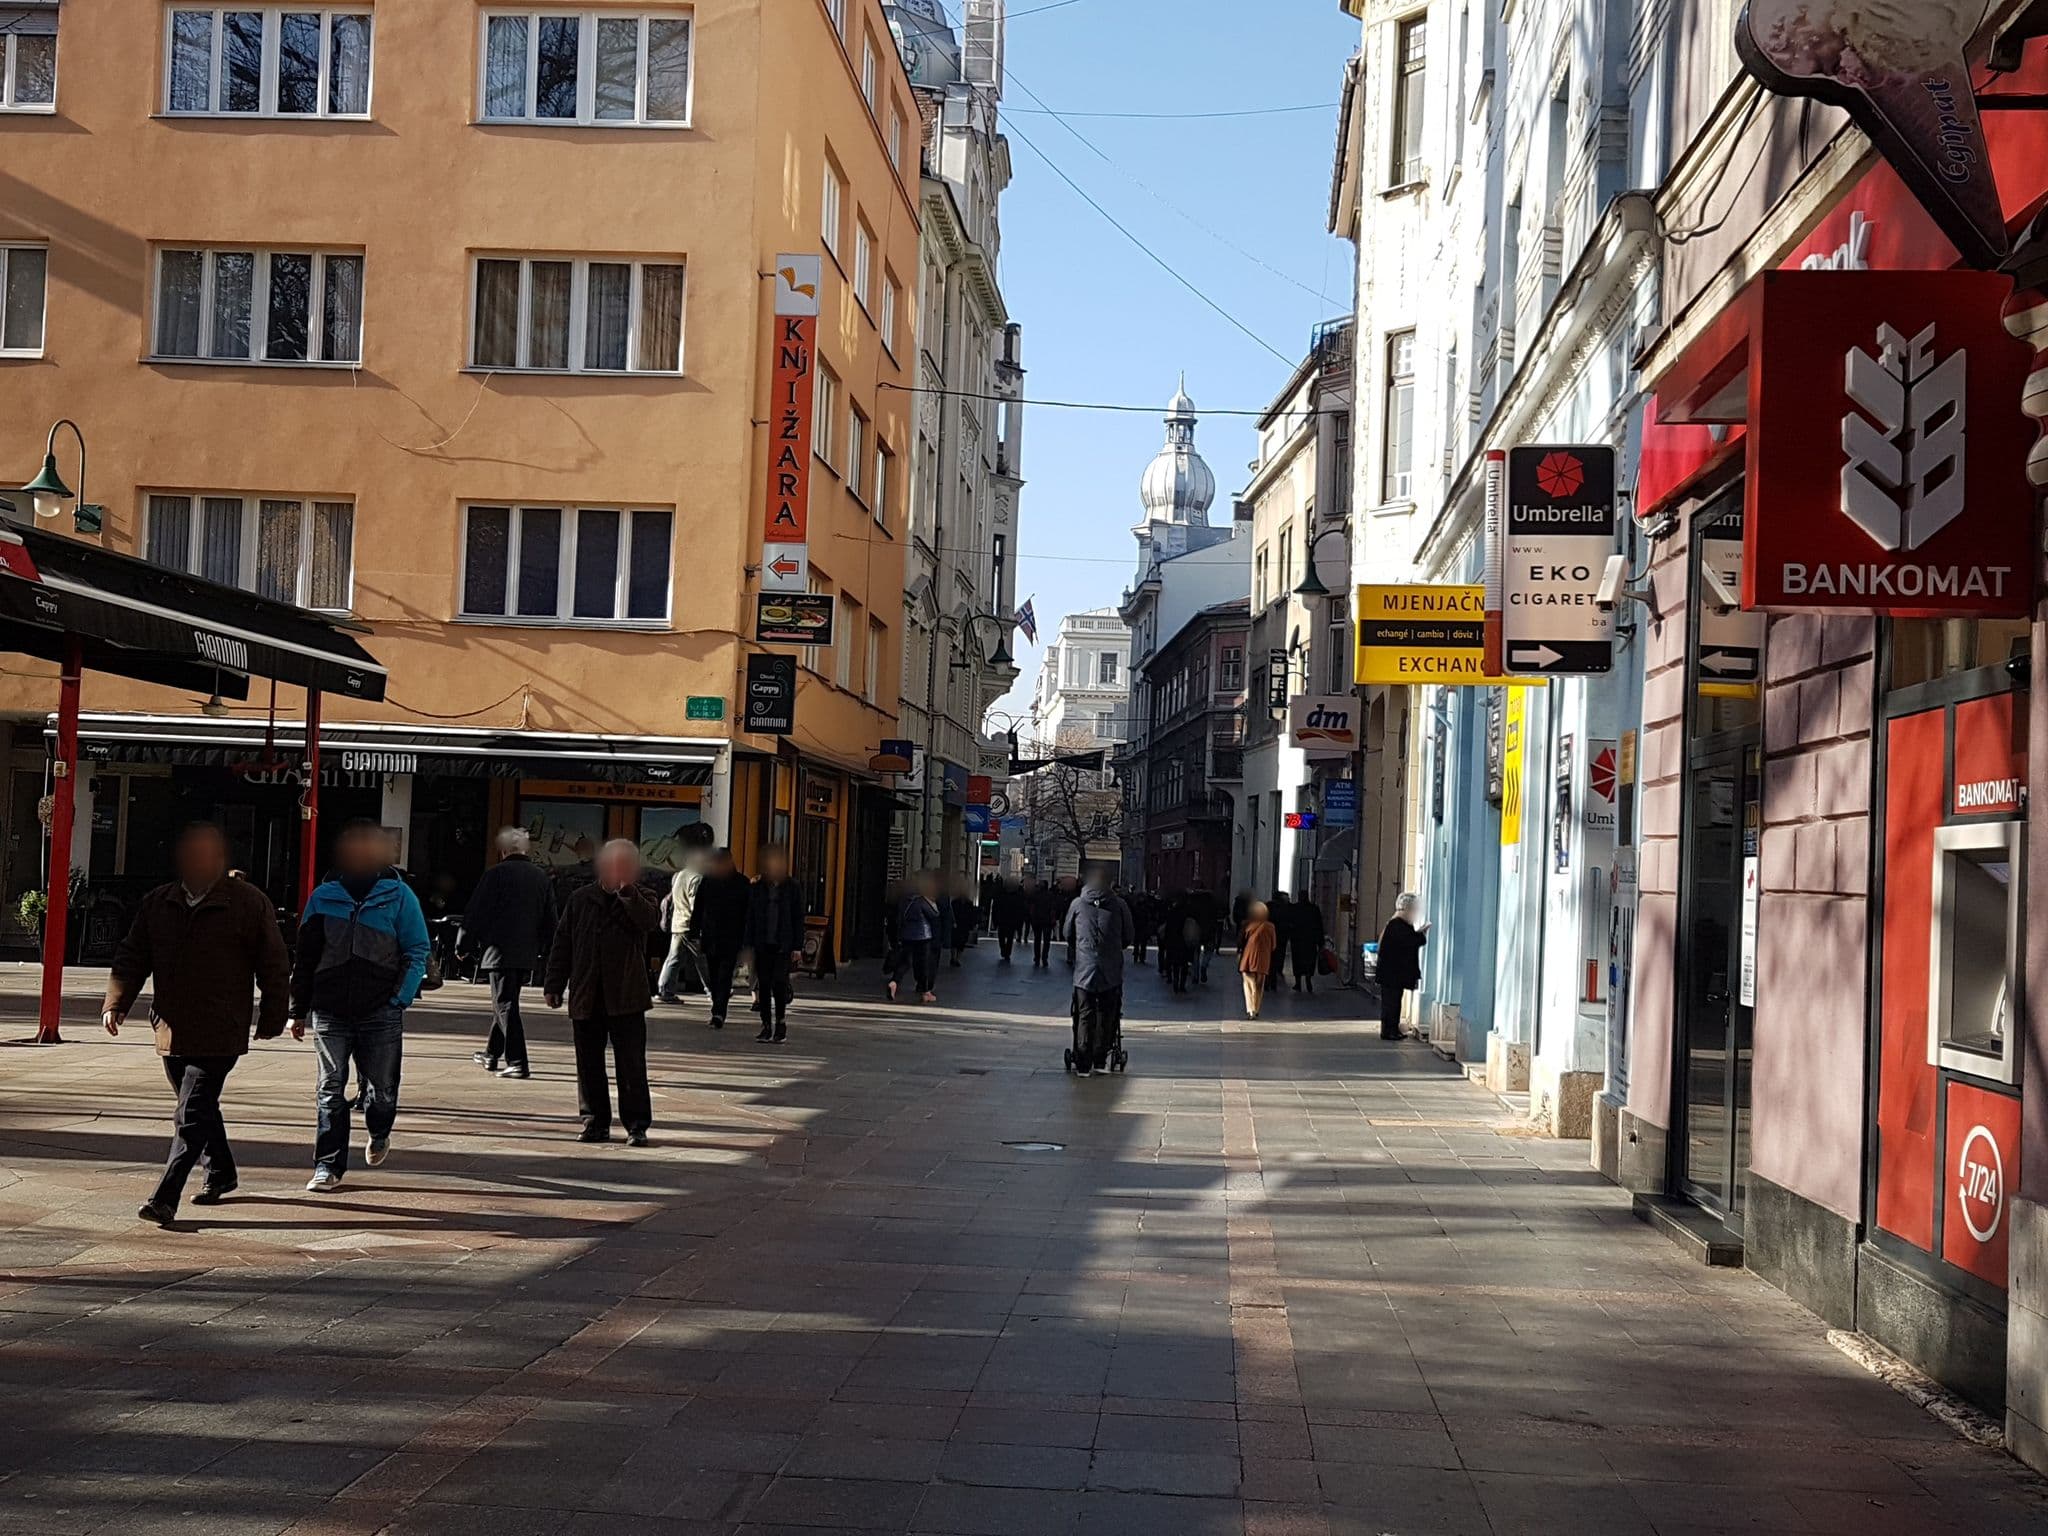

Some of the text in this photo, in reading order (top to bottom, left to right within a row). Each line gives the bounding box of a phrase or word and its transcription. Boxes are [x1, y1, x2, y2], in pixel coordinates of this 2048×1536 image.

[1487, 469, 1500, 533] Umbrella
[1512, 504, 1604, 522] Umbrella
[1530, 566, 1590, 581] EKO
[1782, 563, 2012, 598] BANKOMAT
[194, 631, 248, 670] GIANNINI
[752, 683, 780, 695] Cappy
[750, 716, 787, 728] GIANNINI
[1306, 704, 1348, 728] dm
[342, 751, 417, 773] GIANNINI
[1958, 778, 2020, 808] BANKOMAT
[1967, 1161, 1997, 1206] 7/24
